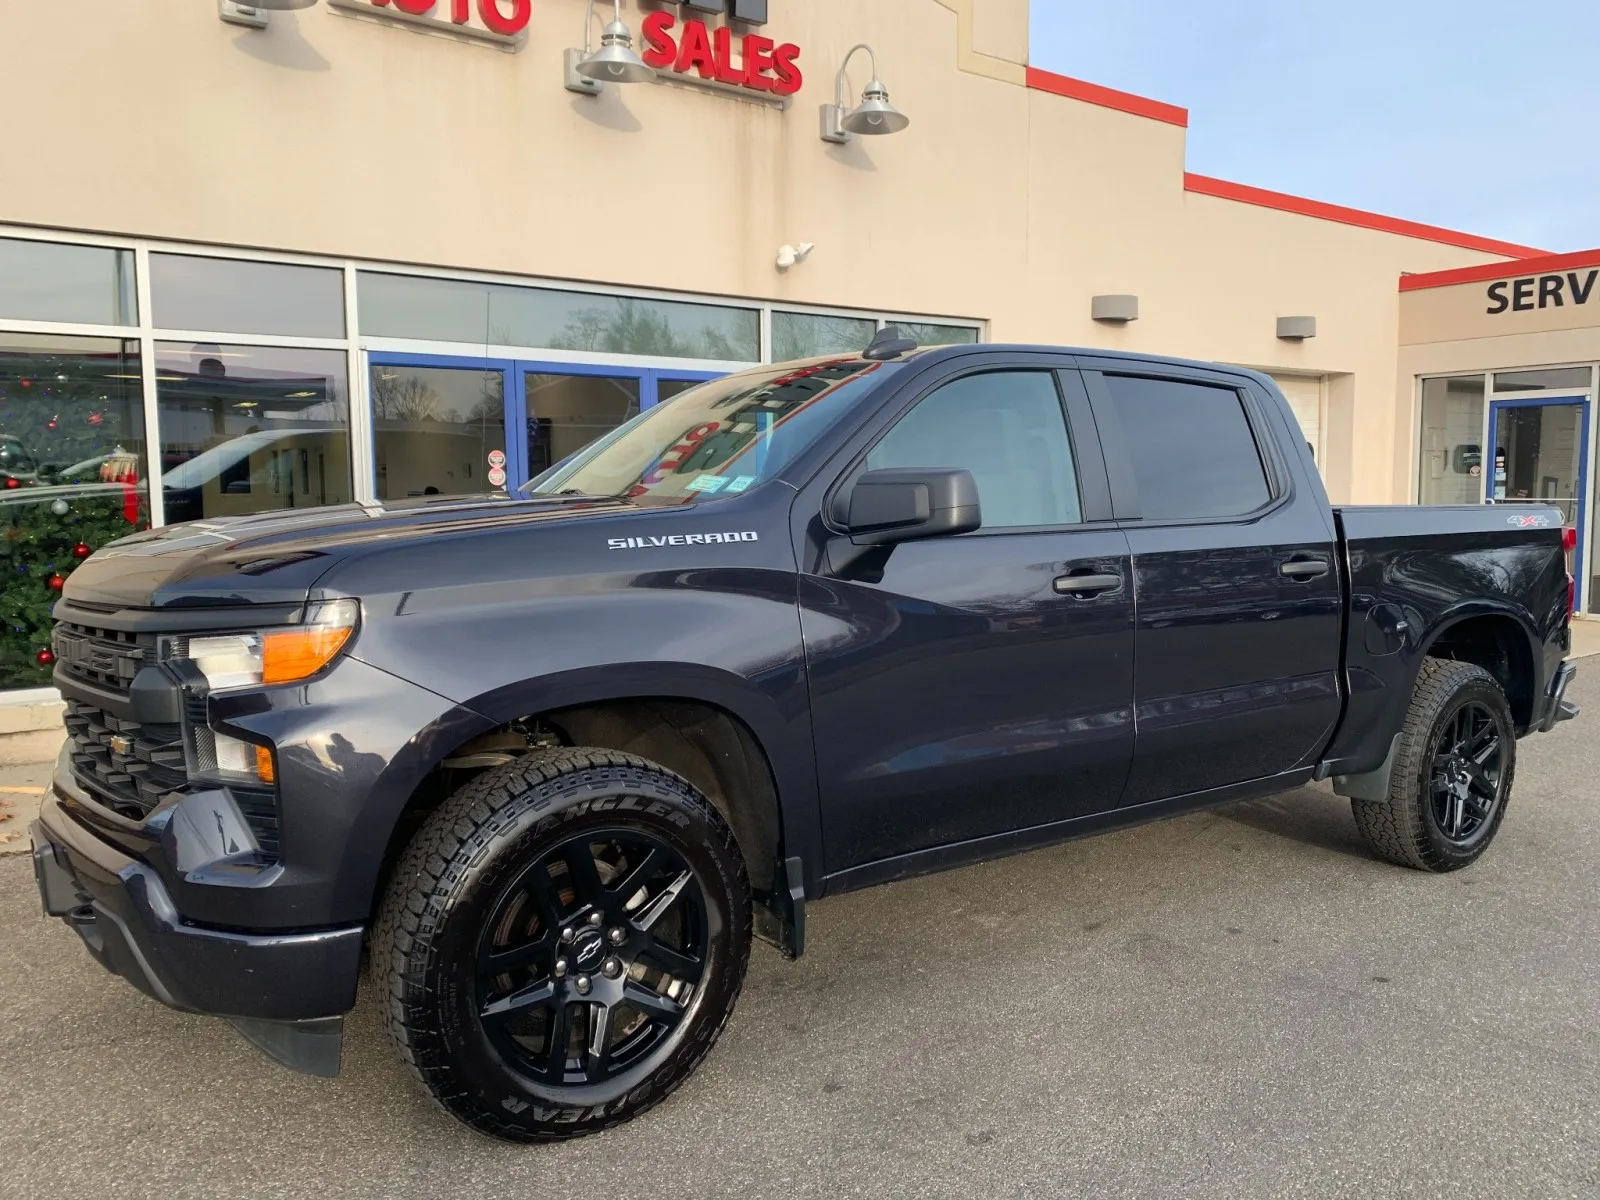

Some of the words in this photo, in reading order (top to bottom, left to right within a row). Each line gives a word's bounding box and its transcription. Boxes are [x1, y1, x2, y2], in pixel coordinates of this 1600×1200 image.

[642, 11, 802, 96] SALES
[1486, 270, 1599, 314] SERV
[607, 531, 758, 549] SILVERADO
